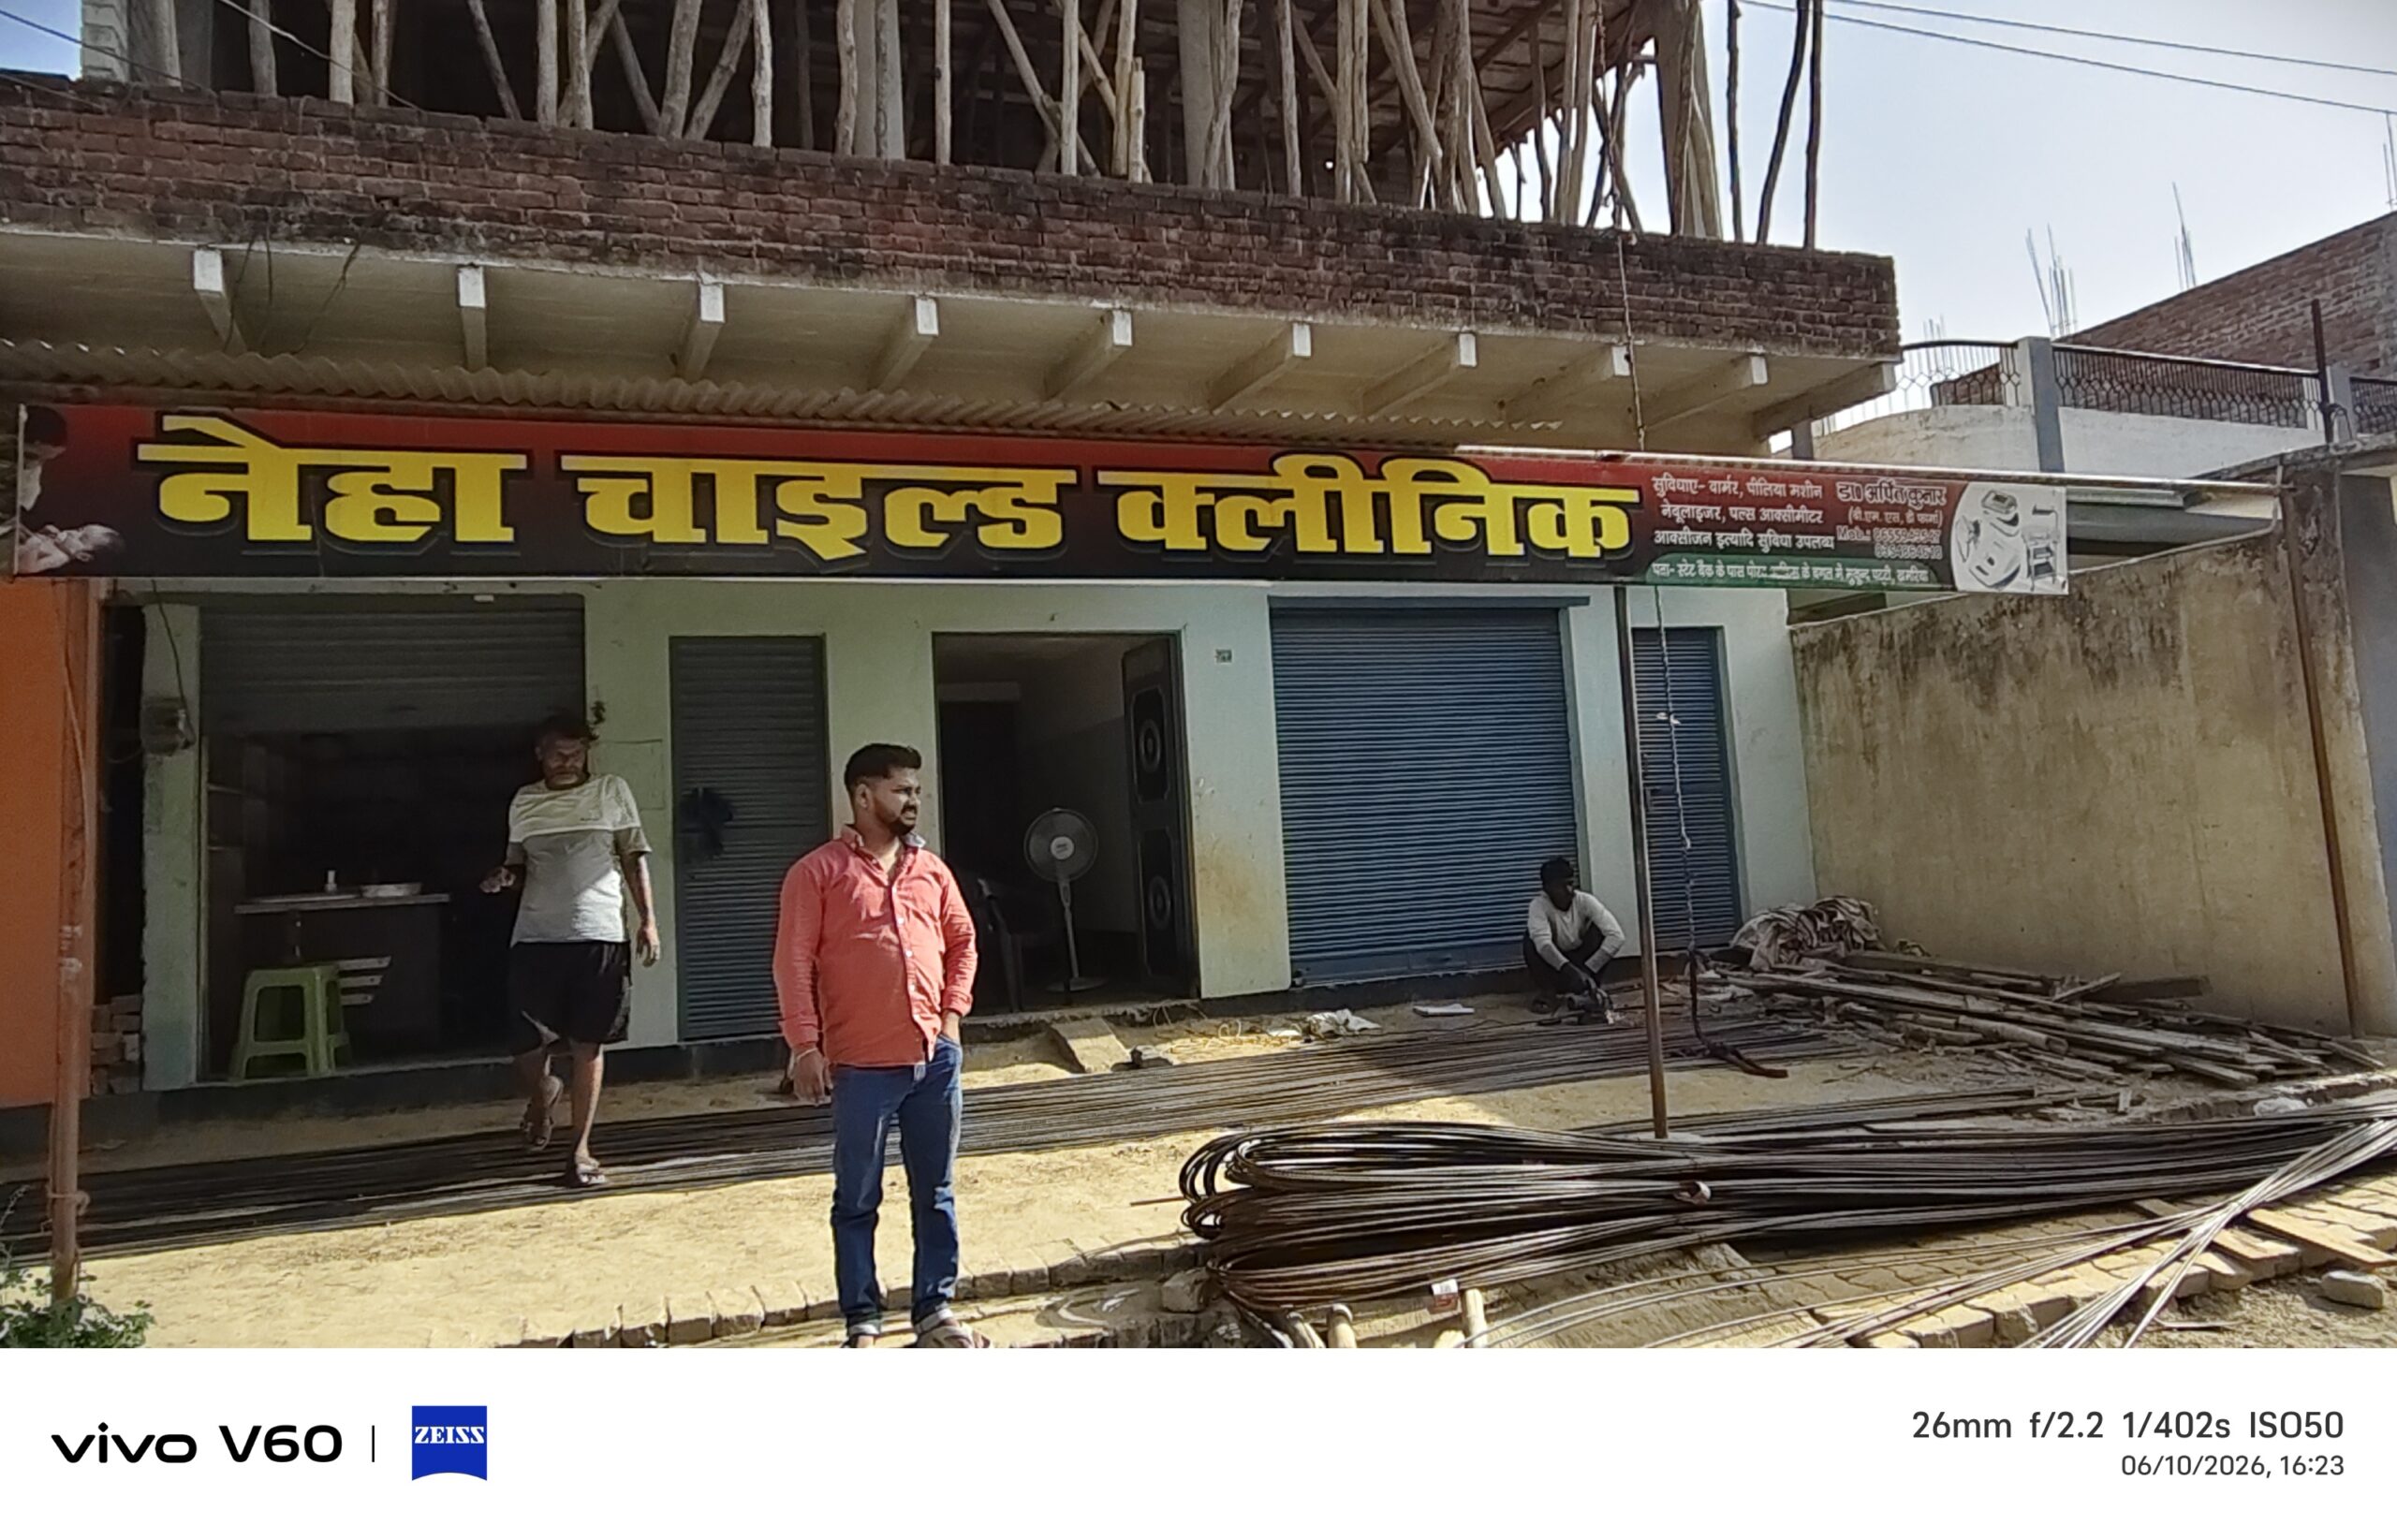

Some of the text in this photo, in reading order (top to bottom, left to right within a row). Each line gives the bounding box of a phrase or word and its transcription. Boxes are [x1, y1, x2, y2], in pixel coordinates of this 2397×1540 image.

[137, 415, 1640, 564] नेहा चाइल्ड क्लीनिक
[1745, 477, 1787, 498] पीलिया
[1788, 479, 1823, 499] मशीन
[1864, 477, 1906, 505] अर्पित
[1906, 485, 1948, 510] कुमार
[1728, 506, 1757, 521] पल्स
[1759, 504, 1824, 523] आक्सीमीटर
[1654, 526, 1713, 546] आक्सीजन
[1714, 527, 1755, 550] इत्यादि
[1757, 529, 1793, 554] सुविधा
[1727, 565, 1744, 579] पास
